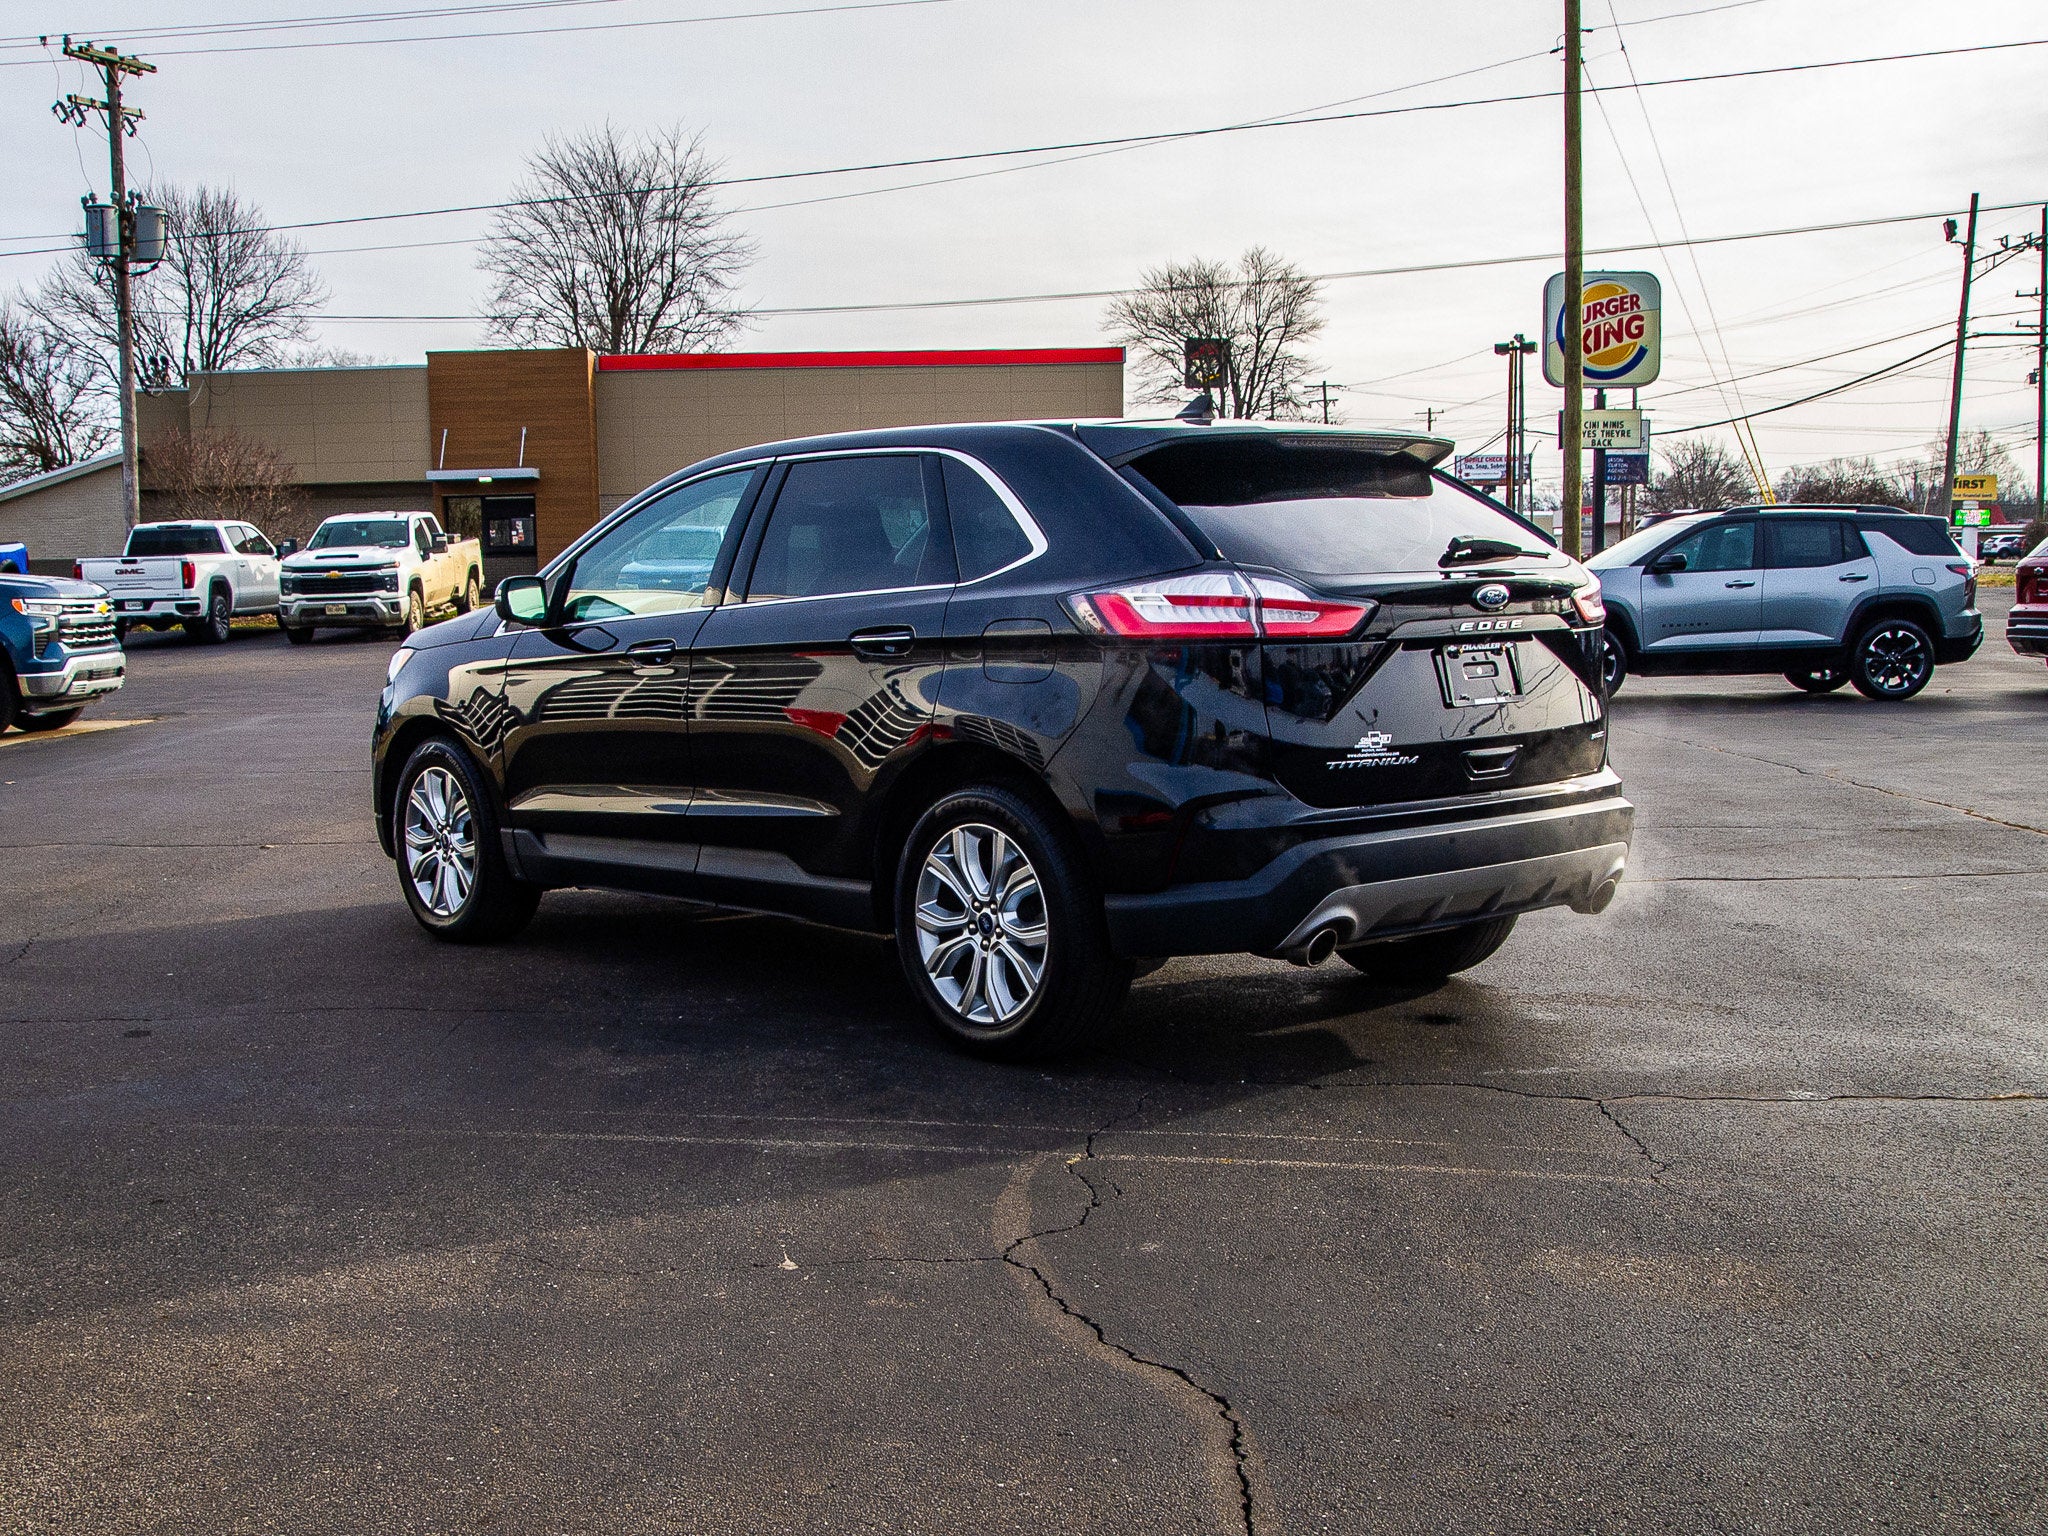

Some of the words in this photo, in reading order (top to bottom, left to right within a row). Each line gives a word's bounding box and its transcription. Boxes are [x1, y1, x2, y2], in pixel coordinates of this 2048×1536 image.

[1582, 293, 1641, 325] URGER
[1583, 420, 1600, 429] CINI
[1602, 420, 1625, 429] MINIS
[1582, 429, 1597, 438] YES
[1600, 429, 1632, 438] THEYRE
[1591, 438, 1613, 447] BACK
[1459, 619, 1524, 632] EDGE
[1326, 755, 1420, 770] TITANIUM
